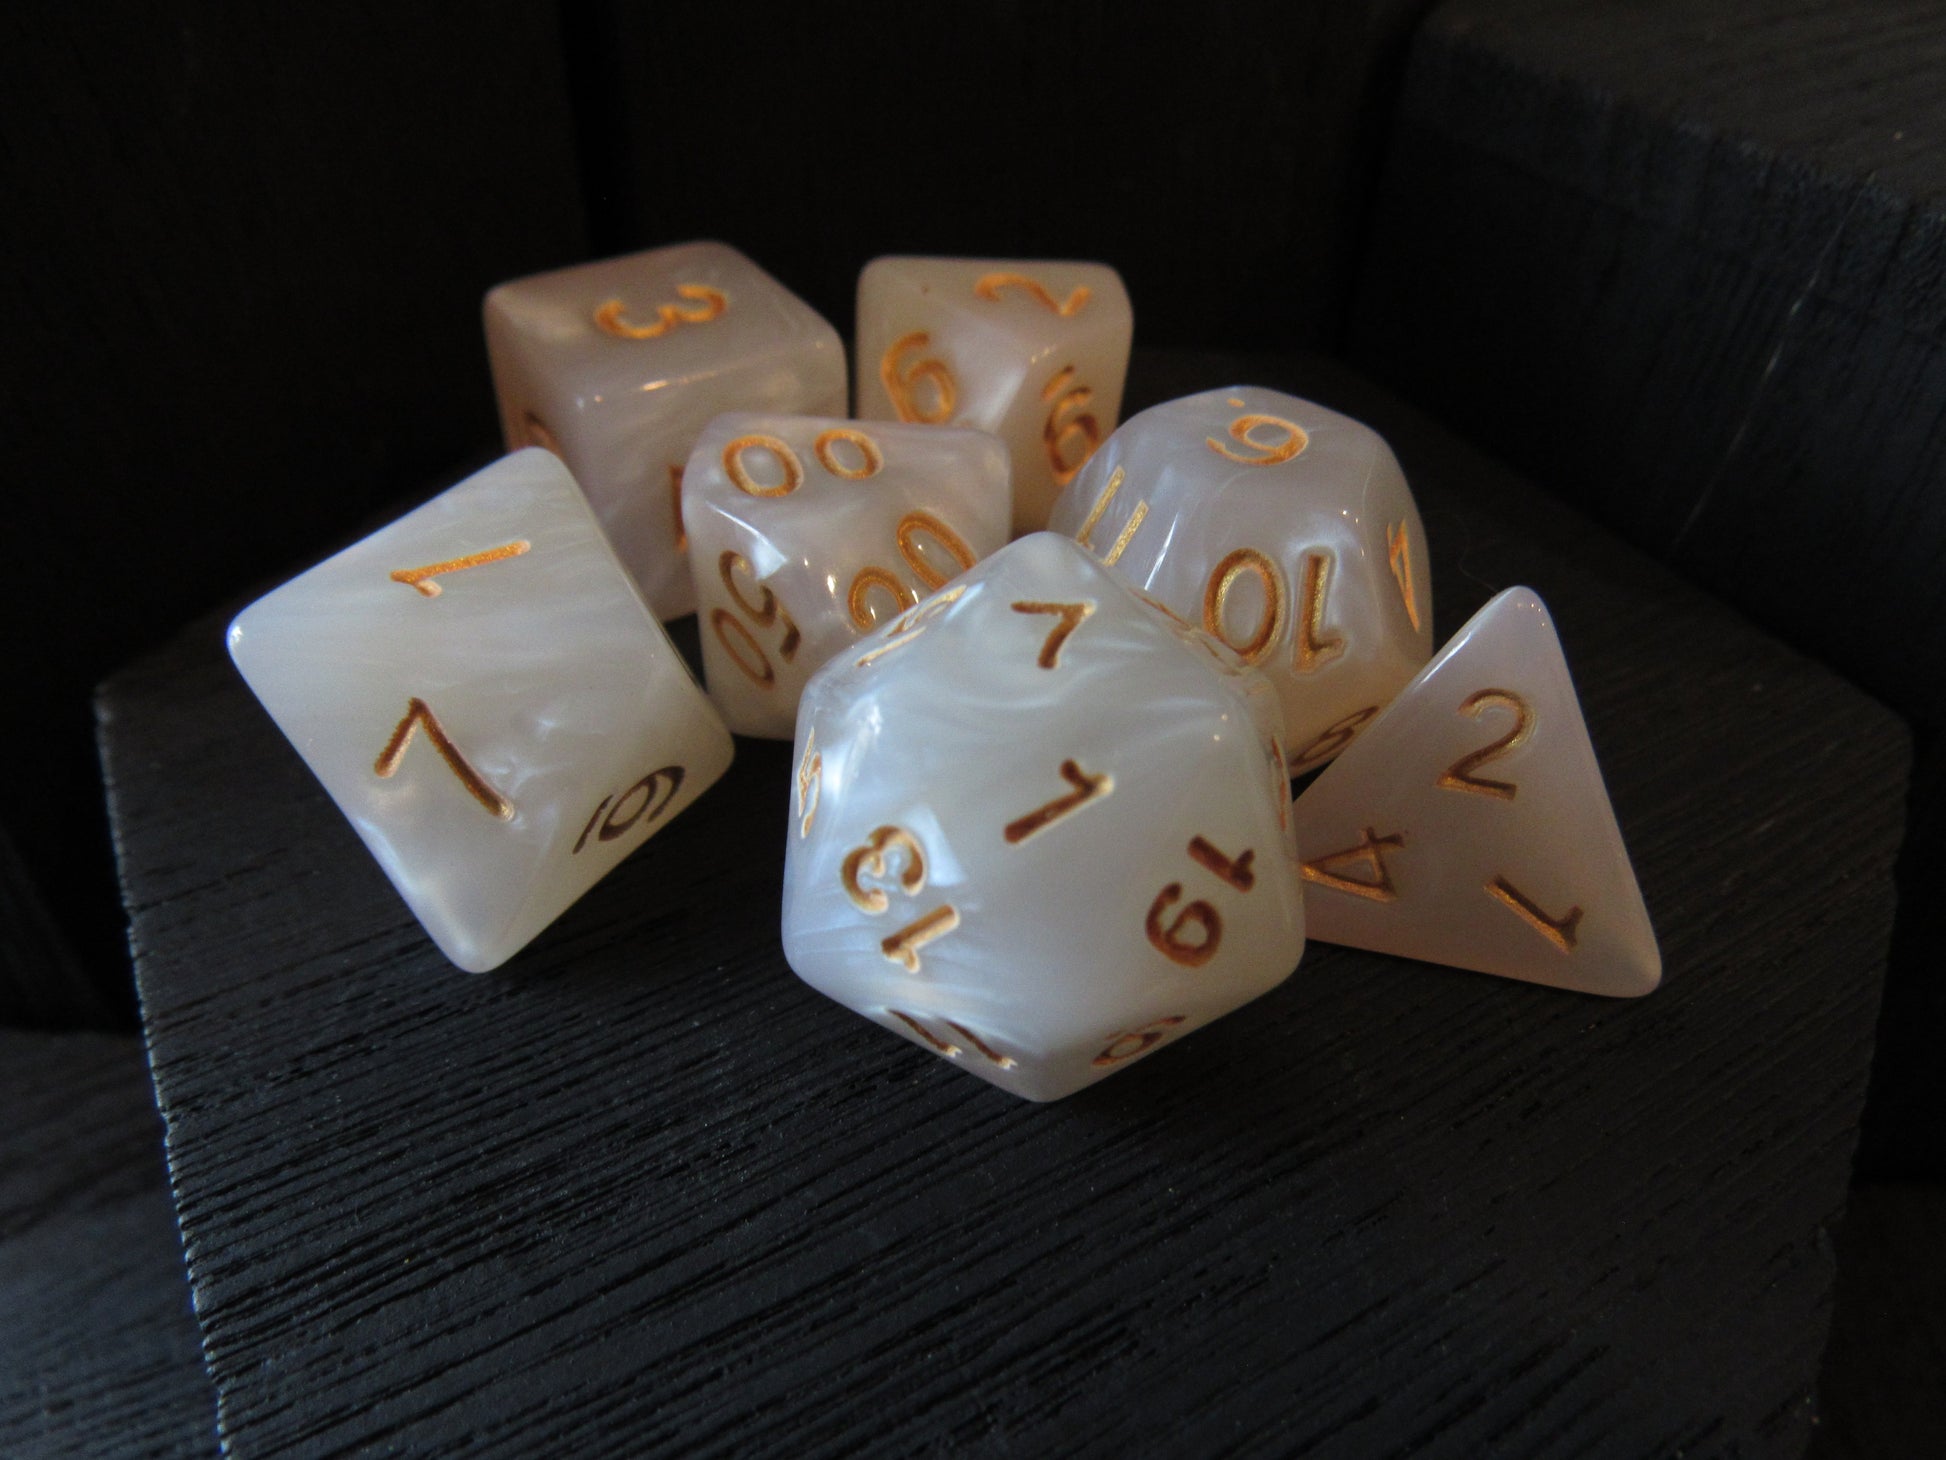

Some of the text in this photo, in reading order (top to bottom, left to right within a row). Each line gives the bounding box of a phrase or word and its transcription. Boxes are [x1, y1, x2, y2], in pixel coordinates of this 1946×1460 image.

[594, 285, 727, 339] 3
[390, 538, 532, 597] 1
[1203, 547, 1347, 674] 10
[710, 550, 800, 690] 50
[1011, 602, 1096, 669] 7
[374, 697, 517, 822] 7
[1437, 688, 1531, 801] 2
[1004, 758, 1114, 845] 1
[841, 825, 962, 975] 13
[1302, 826, 1405, 903] 4
[1484, 874, 1585, 955] 1
